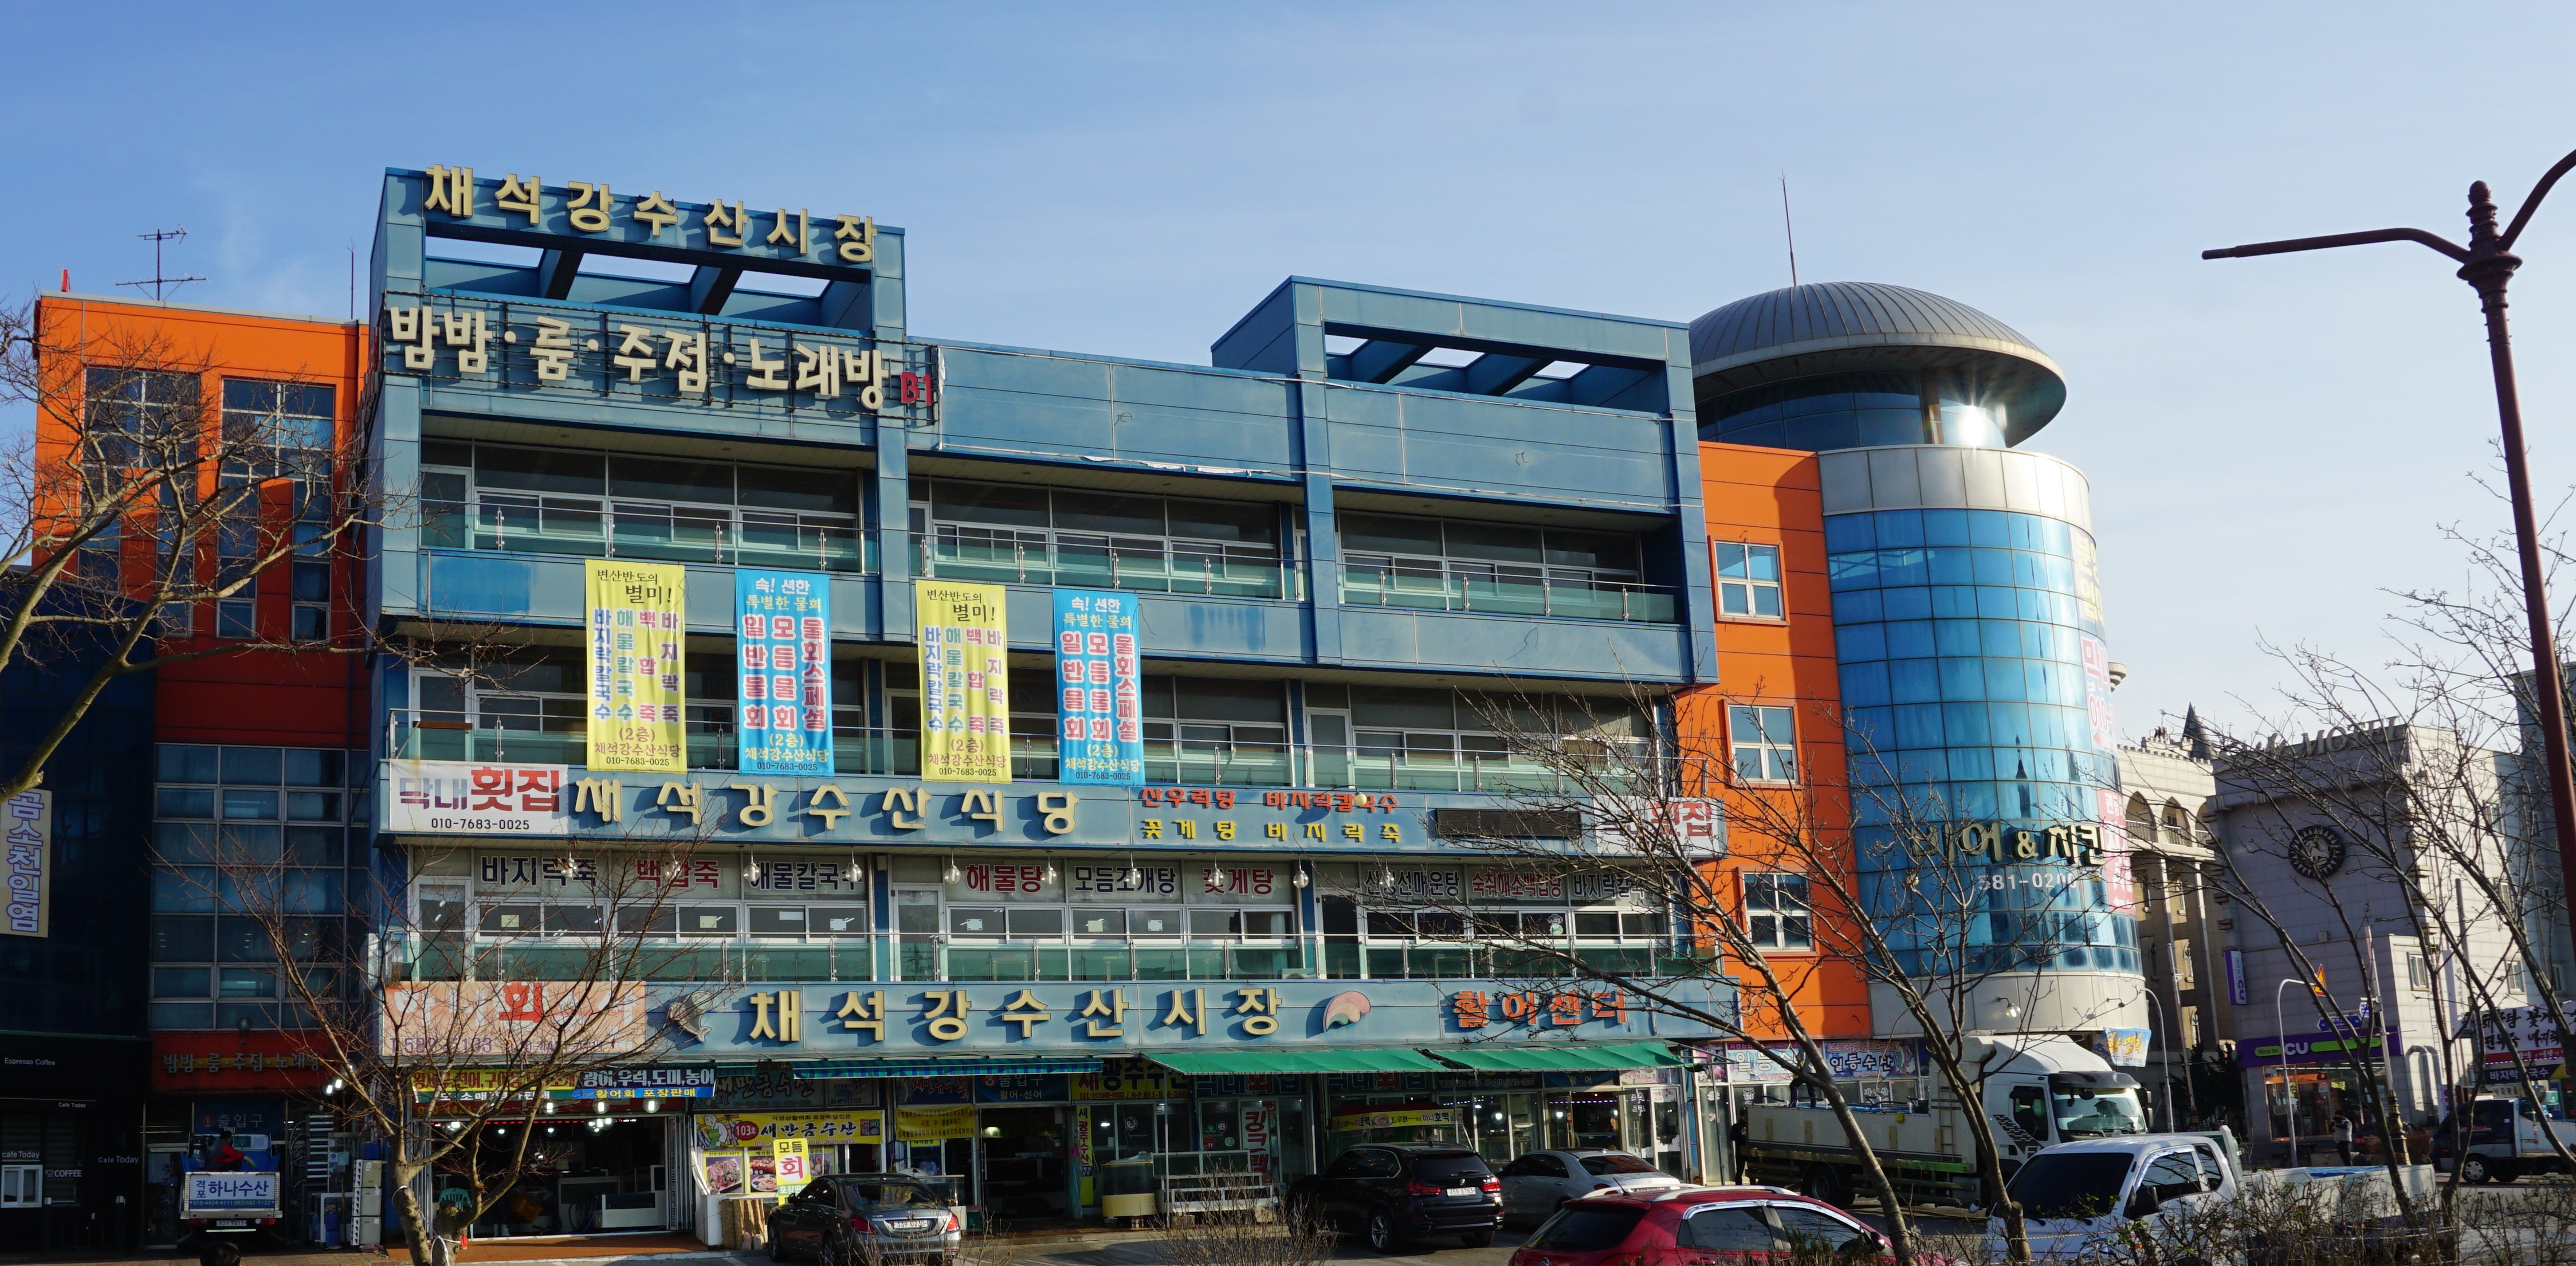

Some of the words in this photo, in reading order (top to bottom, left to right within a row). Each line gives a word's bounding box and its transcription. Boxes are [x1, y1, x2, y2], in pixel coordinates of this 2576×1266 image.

[425, 164, 878, 263] 채석강수산시장
[901, 371, 932, 406] B1
[598, 569, 658, 585] 변산반도의
[755, 578, 775, 593] 속!
[782, 579, 810, 595] 션한
[626, 585, 672, 605] 별미!
[747, 595, 790, 611] 특별한
[794, 597, 822, 612] 물회
[926, 590, 982, 603] 변산반도의
[1071, 597, 1089, 610] 속!
[1095, 598, 1121, 613] 션한
[953, 603, 995, 623] 별미!
[1063, 613, 1102, 628] 특별한
[1107, 614, 1131, 630] 물회
[594, 608, 611, 720] 바지락칼국수
[616, 609, 633, 721] 해물칼국수
[639, 610, 656, 722] 백합죽
[661, 613, 678, 723] 바지락죽
[745, 616, 765, 728] 일반물회
[773, 618, 795, 729] 모듬물회
[803, 619, 826, 730] 물회스페셜
[925, 627, 943, 730] 바지락칼국수
[946, 628, 963, 731] 해물칼국수
[967, 629, 984, 732] 백합죽
[988, 630, 1004, 734] 바지락죽
[1062, 633, 1083, 739] 일반물회
[1089, 634, 1109, 739] 모듬물회
[1116, 636, 1136, 740] 물회스페셜
[619, 727, 655, 743] (2층)
[769, 733, 803, 747] (2층)
[951, 738, 984, 752] (2층)
[594, 743, 681, 758] 채석강수산식당
[745, 747, 828, 763] 채석강수산식당
[928, 753, 1007, 768] 채석강수산식당
[1087, 743, 1118, 758] (2층)
[606, 756, 669, 766] 010-7683-0025
[757, 761, 818, 771] 010-7683-0025
[1065, 758, 1140, 772] 채석강수산식당
[938, 767, 996, 776] 010-7683-0025
[1075, 771, 1130, 781] 010-7683-0025
[399, 766, 560, 813] 막내횟집
[575, 777, 1081, 835] 채석강수산식당
[1141, 787, 1236, 810] 산우럭탕
[1265, 790, 1399, 813] 바지락칼국수
[431, 817, 530, 831] 010-7683-0025
[1143, 818, 1236, 841] 꽃게탕
[1267, 822, 1400, 844] 바지락죽
[1911, 822, 2002, 863] 비어
[2016, 830, 2039, 859] &
[2046, 824, 2106, 867] 치킨
[6, 791, 45, 933] 곰소천일염
[482, 856, 598, 887] 바지락죽
[749, 861, 863, 891] 해물칼국수
[966, 864, 1043, 894] 해물탕
[1074, 865, 1176, 895] 모듬조개탕
[1203, 867, 1275, 895] 꽃게탕
[1573, 872, 1656, 899] 바지락칼
[1977, 872, 2078, 891] 581-0200
[498, 982, 543, 1026] 회
[749, 987, 1283, 1042] 채석강수산시장
[1453, 988, 1629, 1029] 활어센터
[2284, 1041, 2308, 1056] CU
[4, 1057, 34, 1065] Espresso
[35, 1058, 56, 1066] Coffee
[1830, 1053, 1894, 1073] 일등수산
[2489, 1067, 2549, 1081] 바지락국수
[595, 1089, 635, 1099] 활어회
[643, 1088, 696, 1098] 포장판매
[217, 1112, 264, 1129] 출입구
[735, 1124, 757, 1136] 103호
[760, 1120, 857, 1138] 새만금수산
[779, 1141, 803, 1153] 모듬
[1244, 1110, 1270, 1173] 킹크랩
[18, 1151, 40, 1159] Today
[115, 1155, 139, 1164] Today
[54, 1169, 83, 1178] COFFEE
[780, 1155, 804, 1179] 회
[207, 1180, 269, 1197] 하나수산
